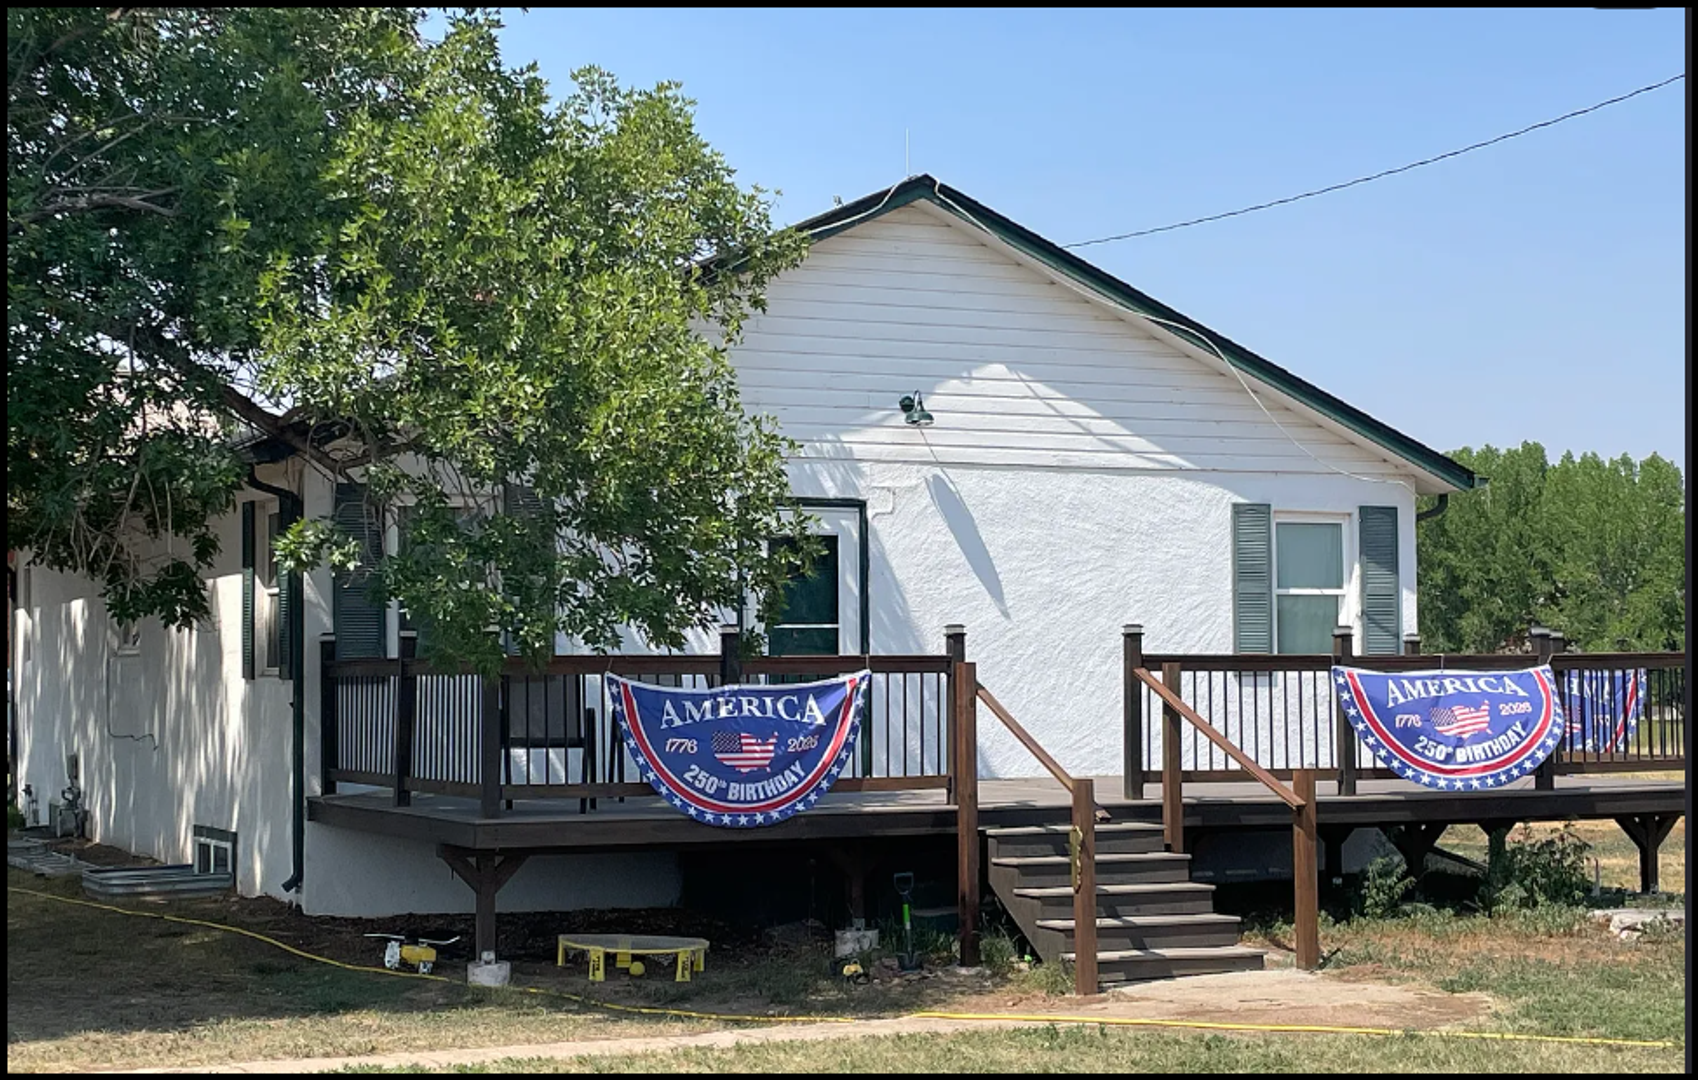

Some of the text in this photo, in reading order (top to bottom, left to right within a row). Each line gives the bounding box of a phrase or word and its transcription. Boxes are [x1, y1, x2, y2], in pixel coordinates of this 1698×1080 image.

[1387, 675, 1530, 708] AMERICA
[660, 693, 826, 729] AMERICA
[1395, 714, 1423, 728] 1776
[665, 738, 698, 754] 1776
[1414, 720, 1527, 762] 250 BIRTHDAY
[727, 760, 806, 800] BIRTHDAY
